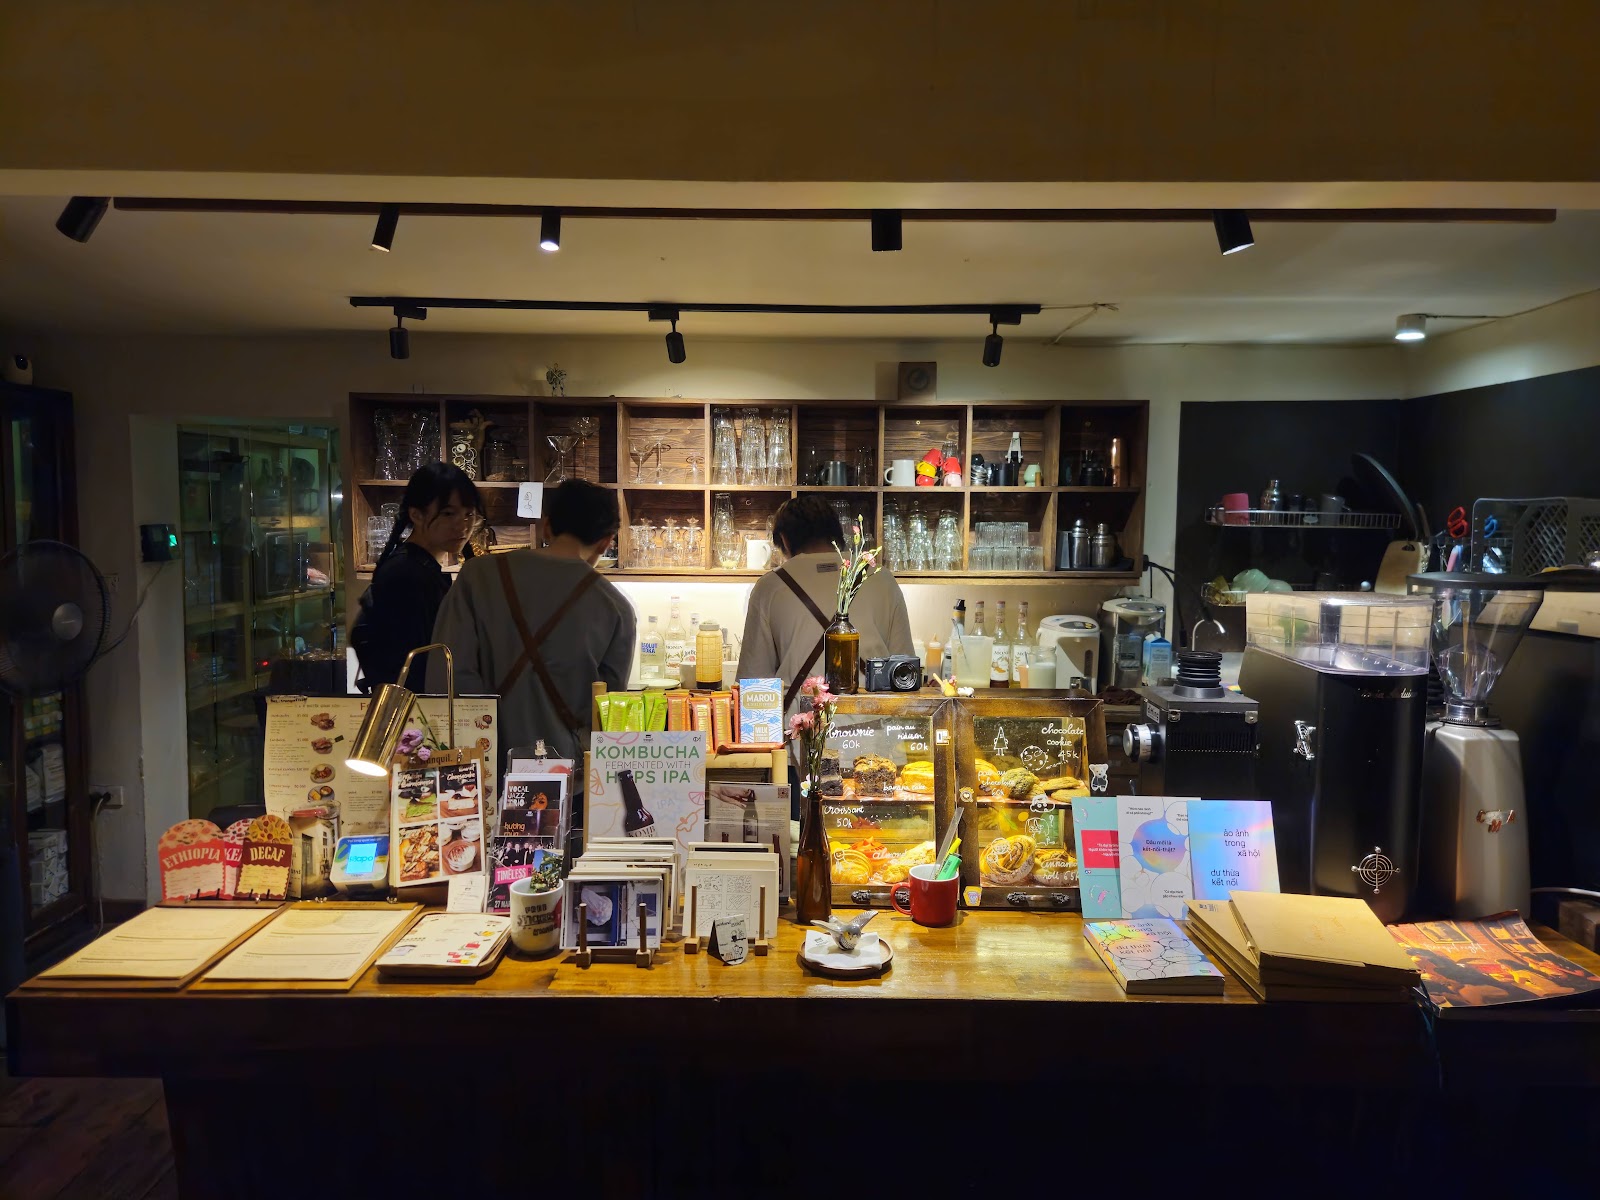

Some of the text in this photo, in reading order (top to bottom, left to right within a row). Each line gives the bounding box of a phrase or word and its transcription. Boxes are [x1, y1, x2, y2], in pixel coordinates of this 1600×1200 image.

[746, 693, 776, 703] MAROU
[826, 721, 875, 739] brownie
[842, 739, 861, 750] 60k
[910, 741, 929, 751] 60k
[1046, 736, 1073, 747] cookie
[595, 745, 700, 760] KOMBUCHA
[1057, 750, 1079, 761] 45k
[605, 760, 691, 770] FERMENTED WITH
[606, 770, 691, 784] HPS IPA
[508, 785, 530, 793] VOCAL
[508, 798, 526, 807] TRIO
[836, 817, 853, 829] 50k
[1224, 839, 1246, 848] trong
[162, 847, 221, 869] ETHIOPIA
[249, 846, 286, 862] DECAF
[1237, 848, 1261, 859] xã hội
[496, 867, 527, 881] TIMELESS
[1211, 877, 1238, 886] kết nối
[494, 900, 502, 908] 27
